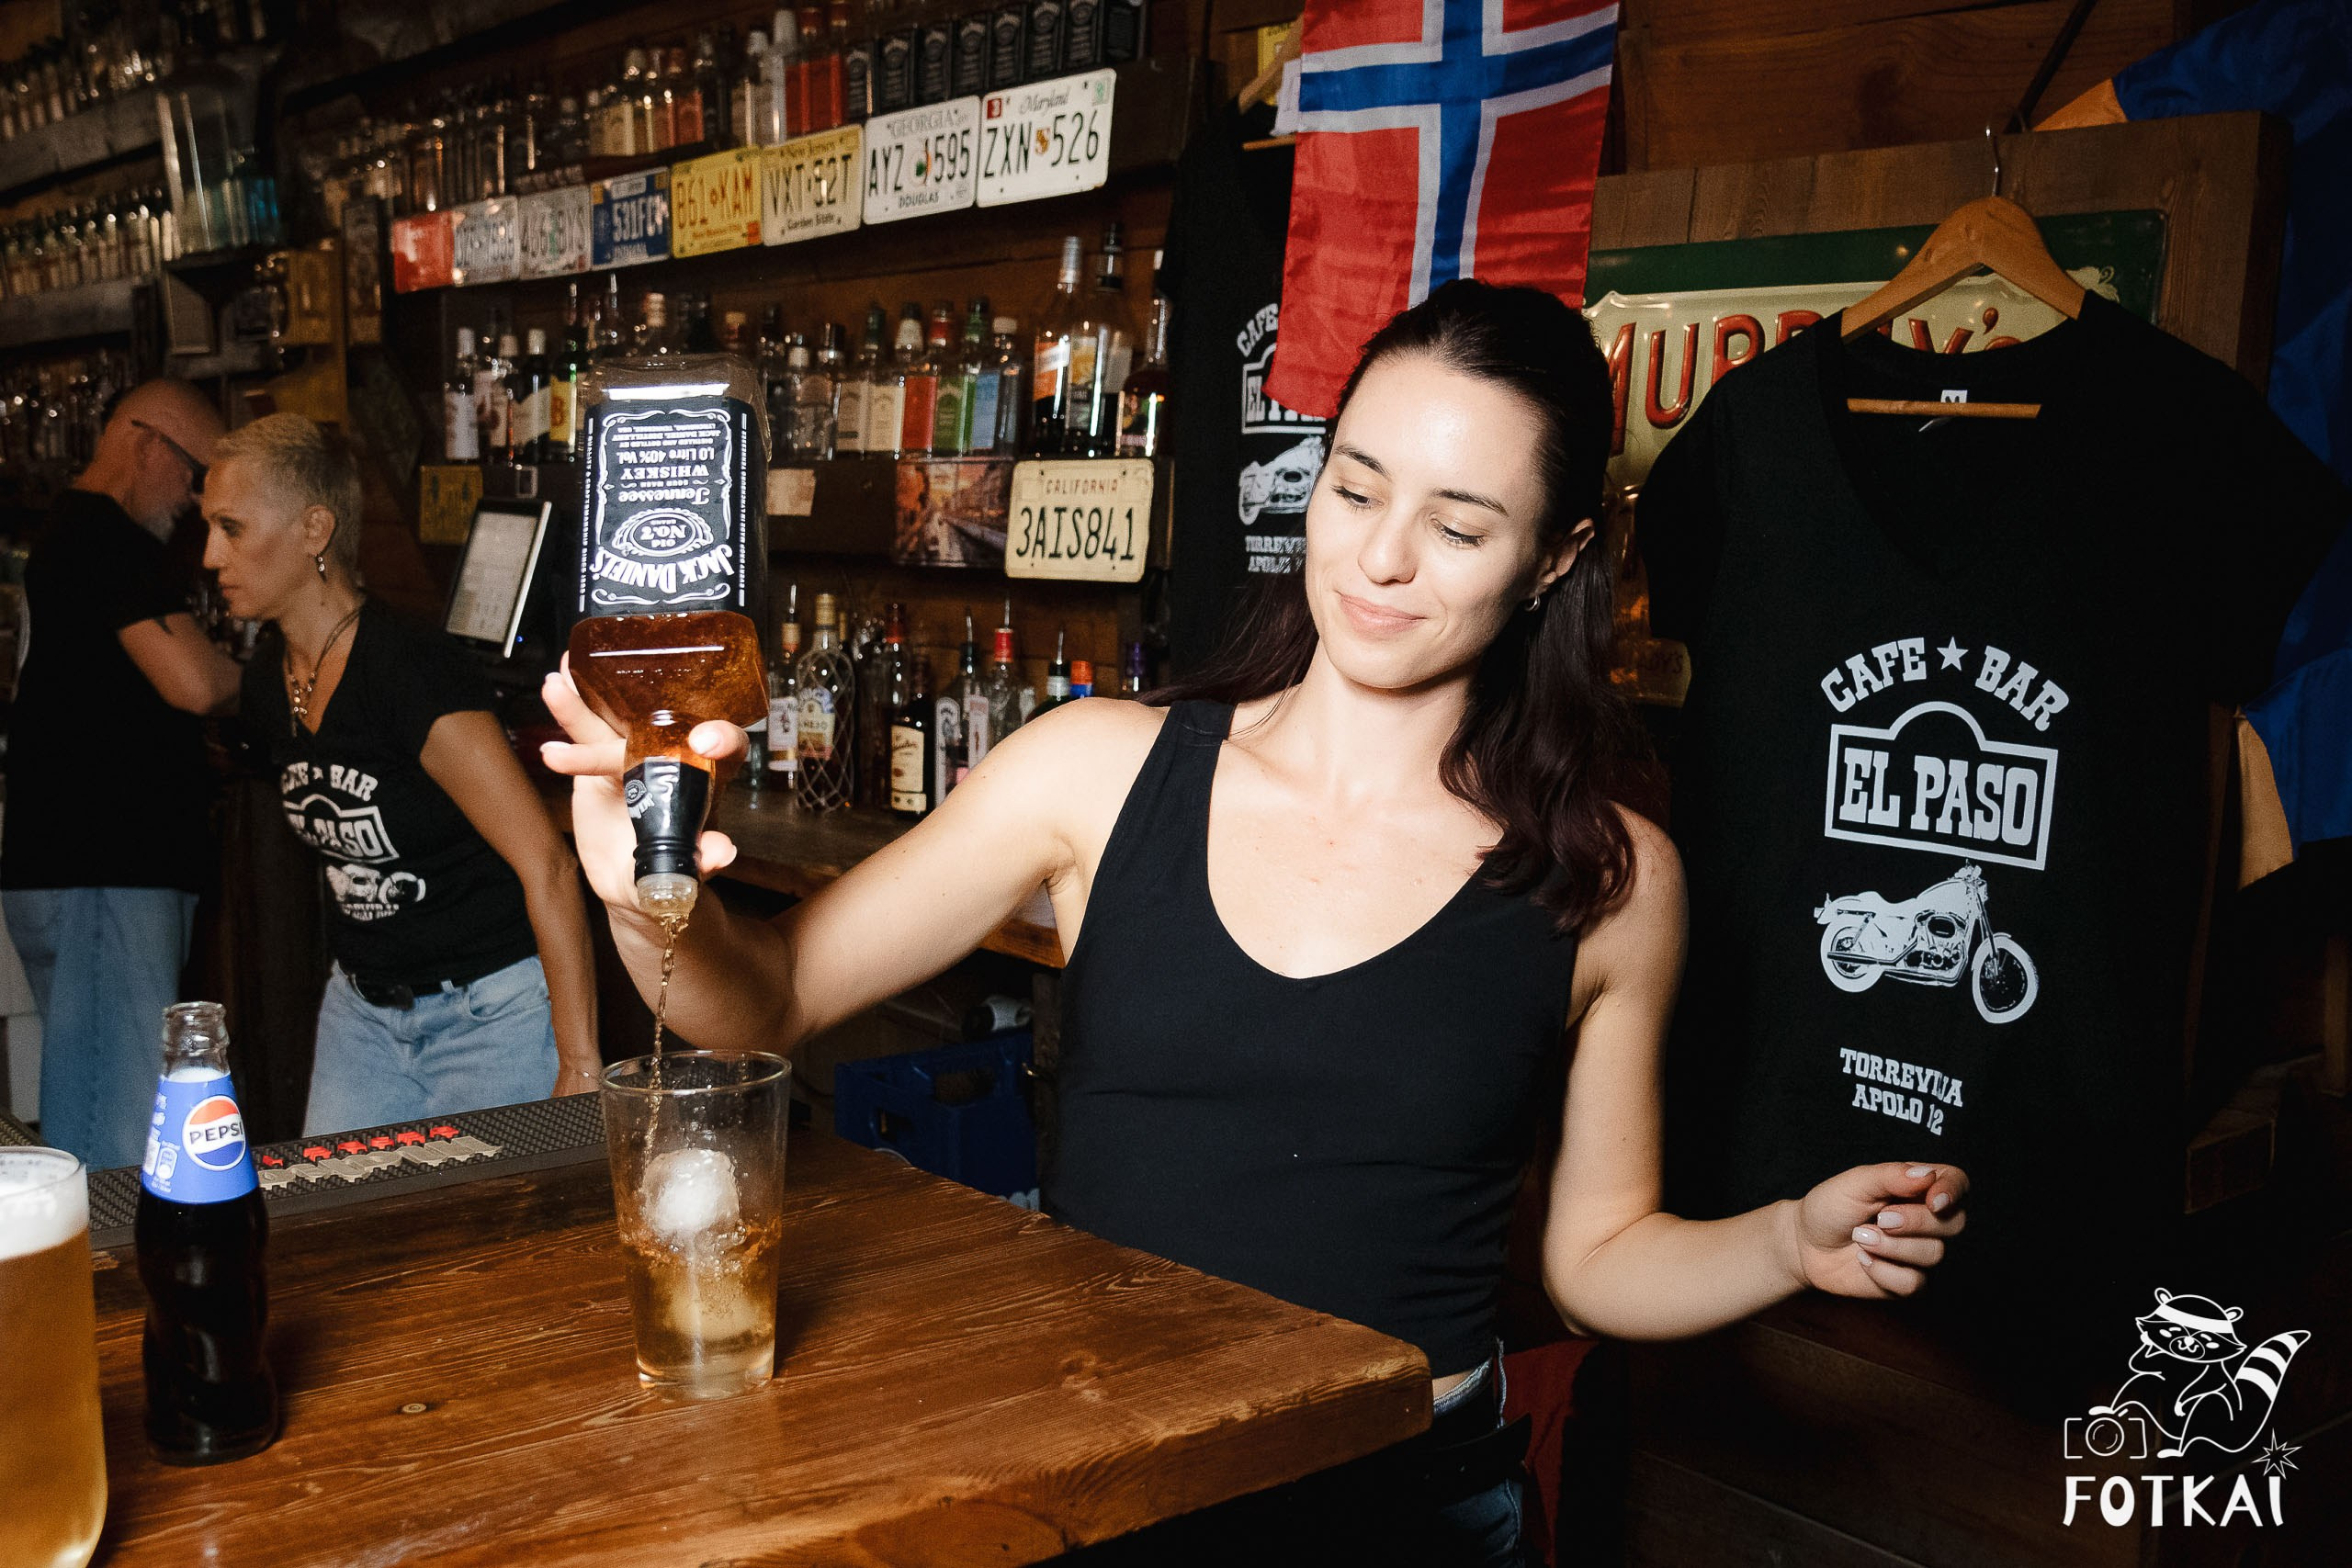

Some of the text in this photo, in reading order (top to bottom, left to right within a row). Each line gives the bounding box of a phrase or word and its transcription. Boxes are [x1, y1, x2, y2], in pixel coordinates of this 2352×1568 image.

[1020, 86, 1071, 117] Maryland
[888, 110, 955, 138] GEORGIA
[984, 109, 1099, 177] ZXN 526
[868, 144, 904, 197] AYZ
[616, 450, 637, 464] Vol.
[638, 449, 667, 463] 40%
[669, 448, 697, 462] Litre
[619, 464, 710, 480] WHISKEY
[1046, 478, 1118, 495] CALIFORNIA
[617, 487, 710, 505] Tennessee
[1016, 506, 1134, 561] 3AIS841
[589, 543, 735, 593] JACK DANIEL'S
[1821, 636, 2070, 732] CAFE BAR
[329, 763, 379, 802] BAR
[1838, 747, 2039, 846] EL PASO
[1851, 1083, 1944, 1136] APOLO 12
[189, 1121, 243, 1145] PEPSI
